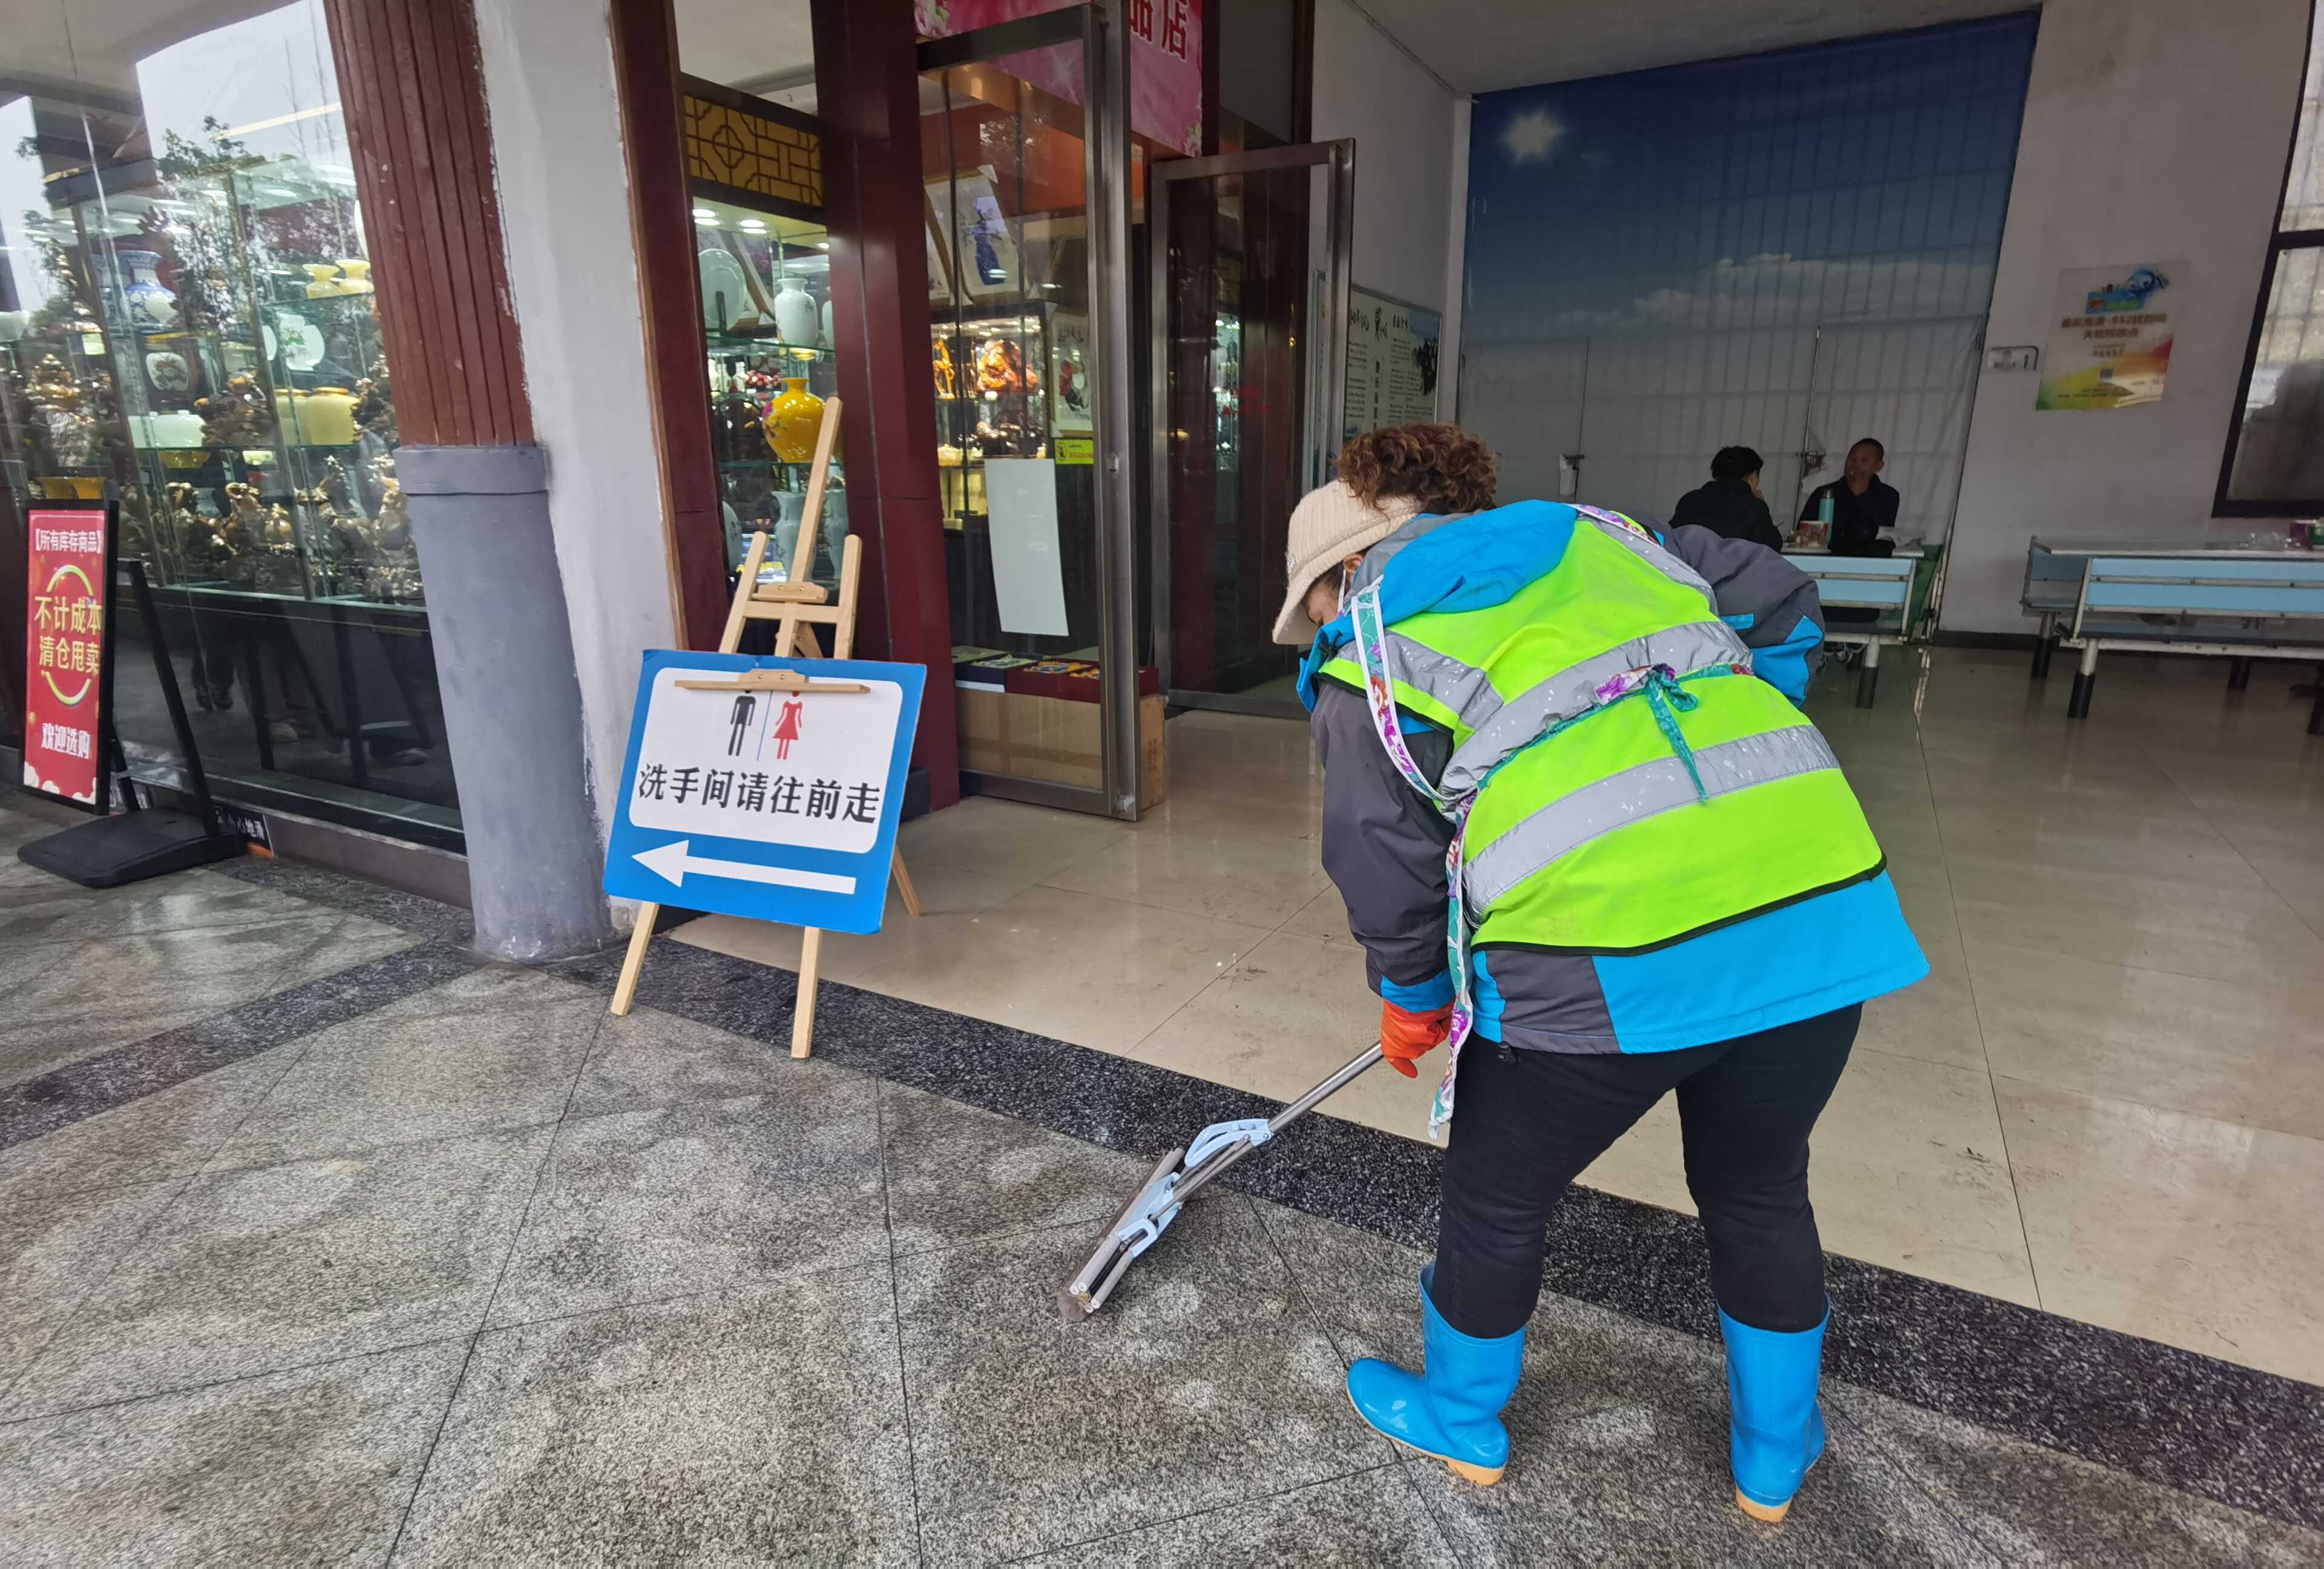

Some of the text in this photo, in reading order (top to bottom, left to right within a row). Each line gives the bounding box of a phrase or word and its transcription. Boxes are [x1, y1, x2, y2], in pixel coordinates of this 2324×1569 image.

[34, 596, 101, 634] 不计成本
[39, 636, 100, 676] 清仓甩卖
[41, 723, 91, 760] 欢迎选购
[637, 763, 881, 824] 洗手间请往前走
